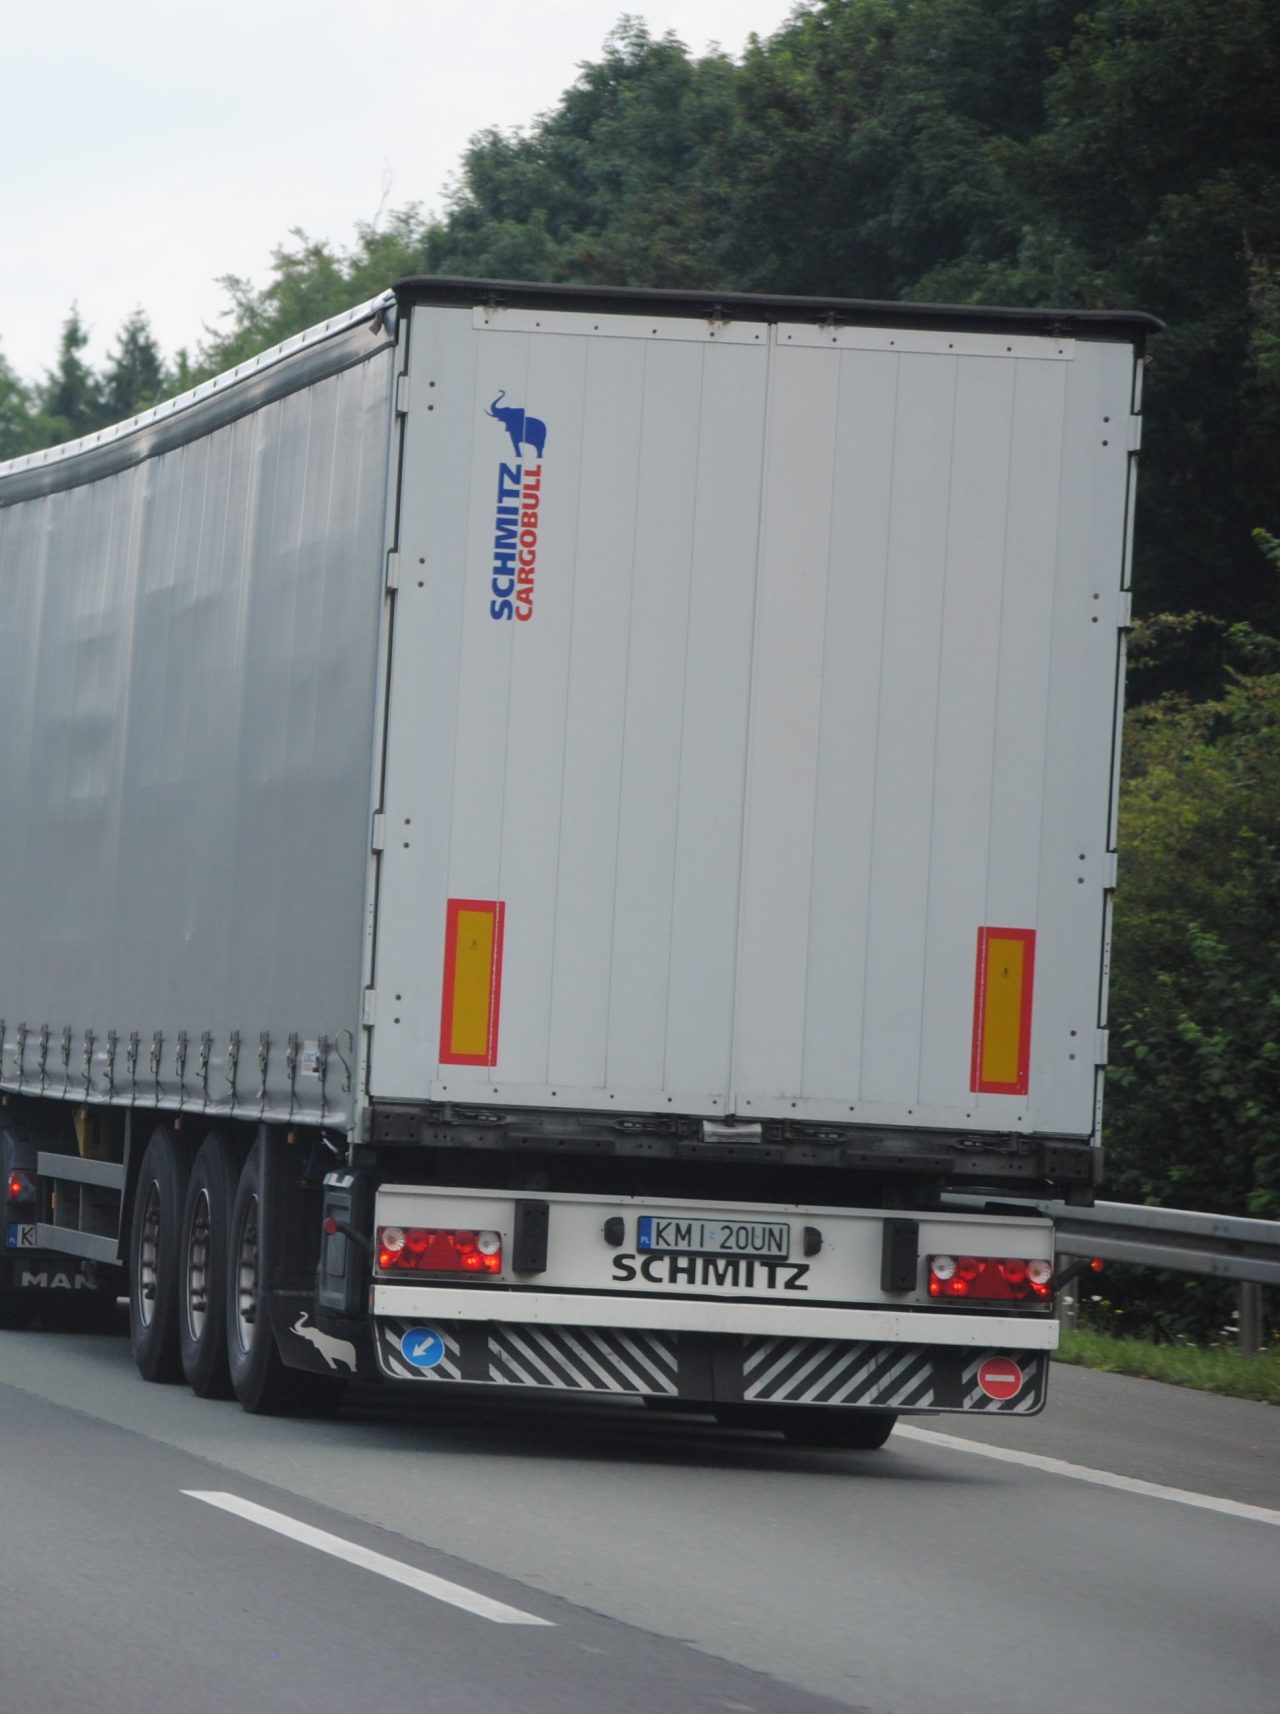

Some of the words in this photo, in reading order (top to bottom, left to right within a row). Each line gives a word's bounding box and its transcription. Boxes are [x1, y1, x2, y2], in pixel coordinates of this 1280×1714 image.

[490, 463, 522, 621] SCHMITZ
[515, 464, 542, 622] CARGOBULL
[612, 1253, 810, 1291] SCHMITZ
